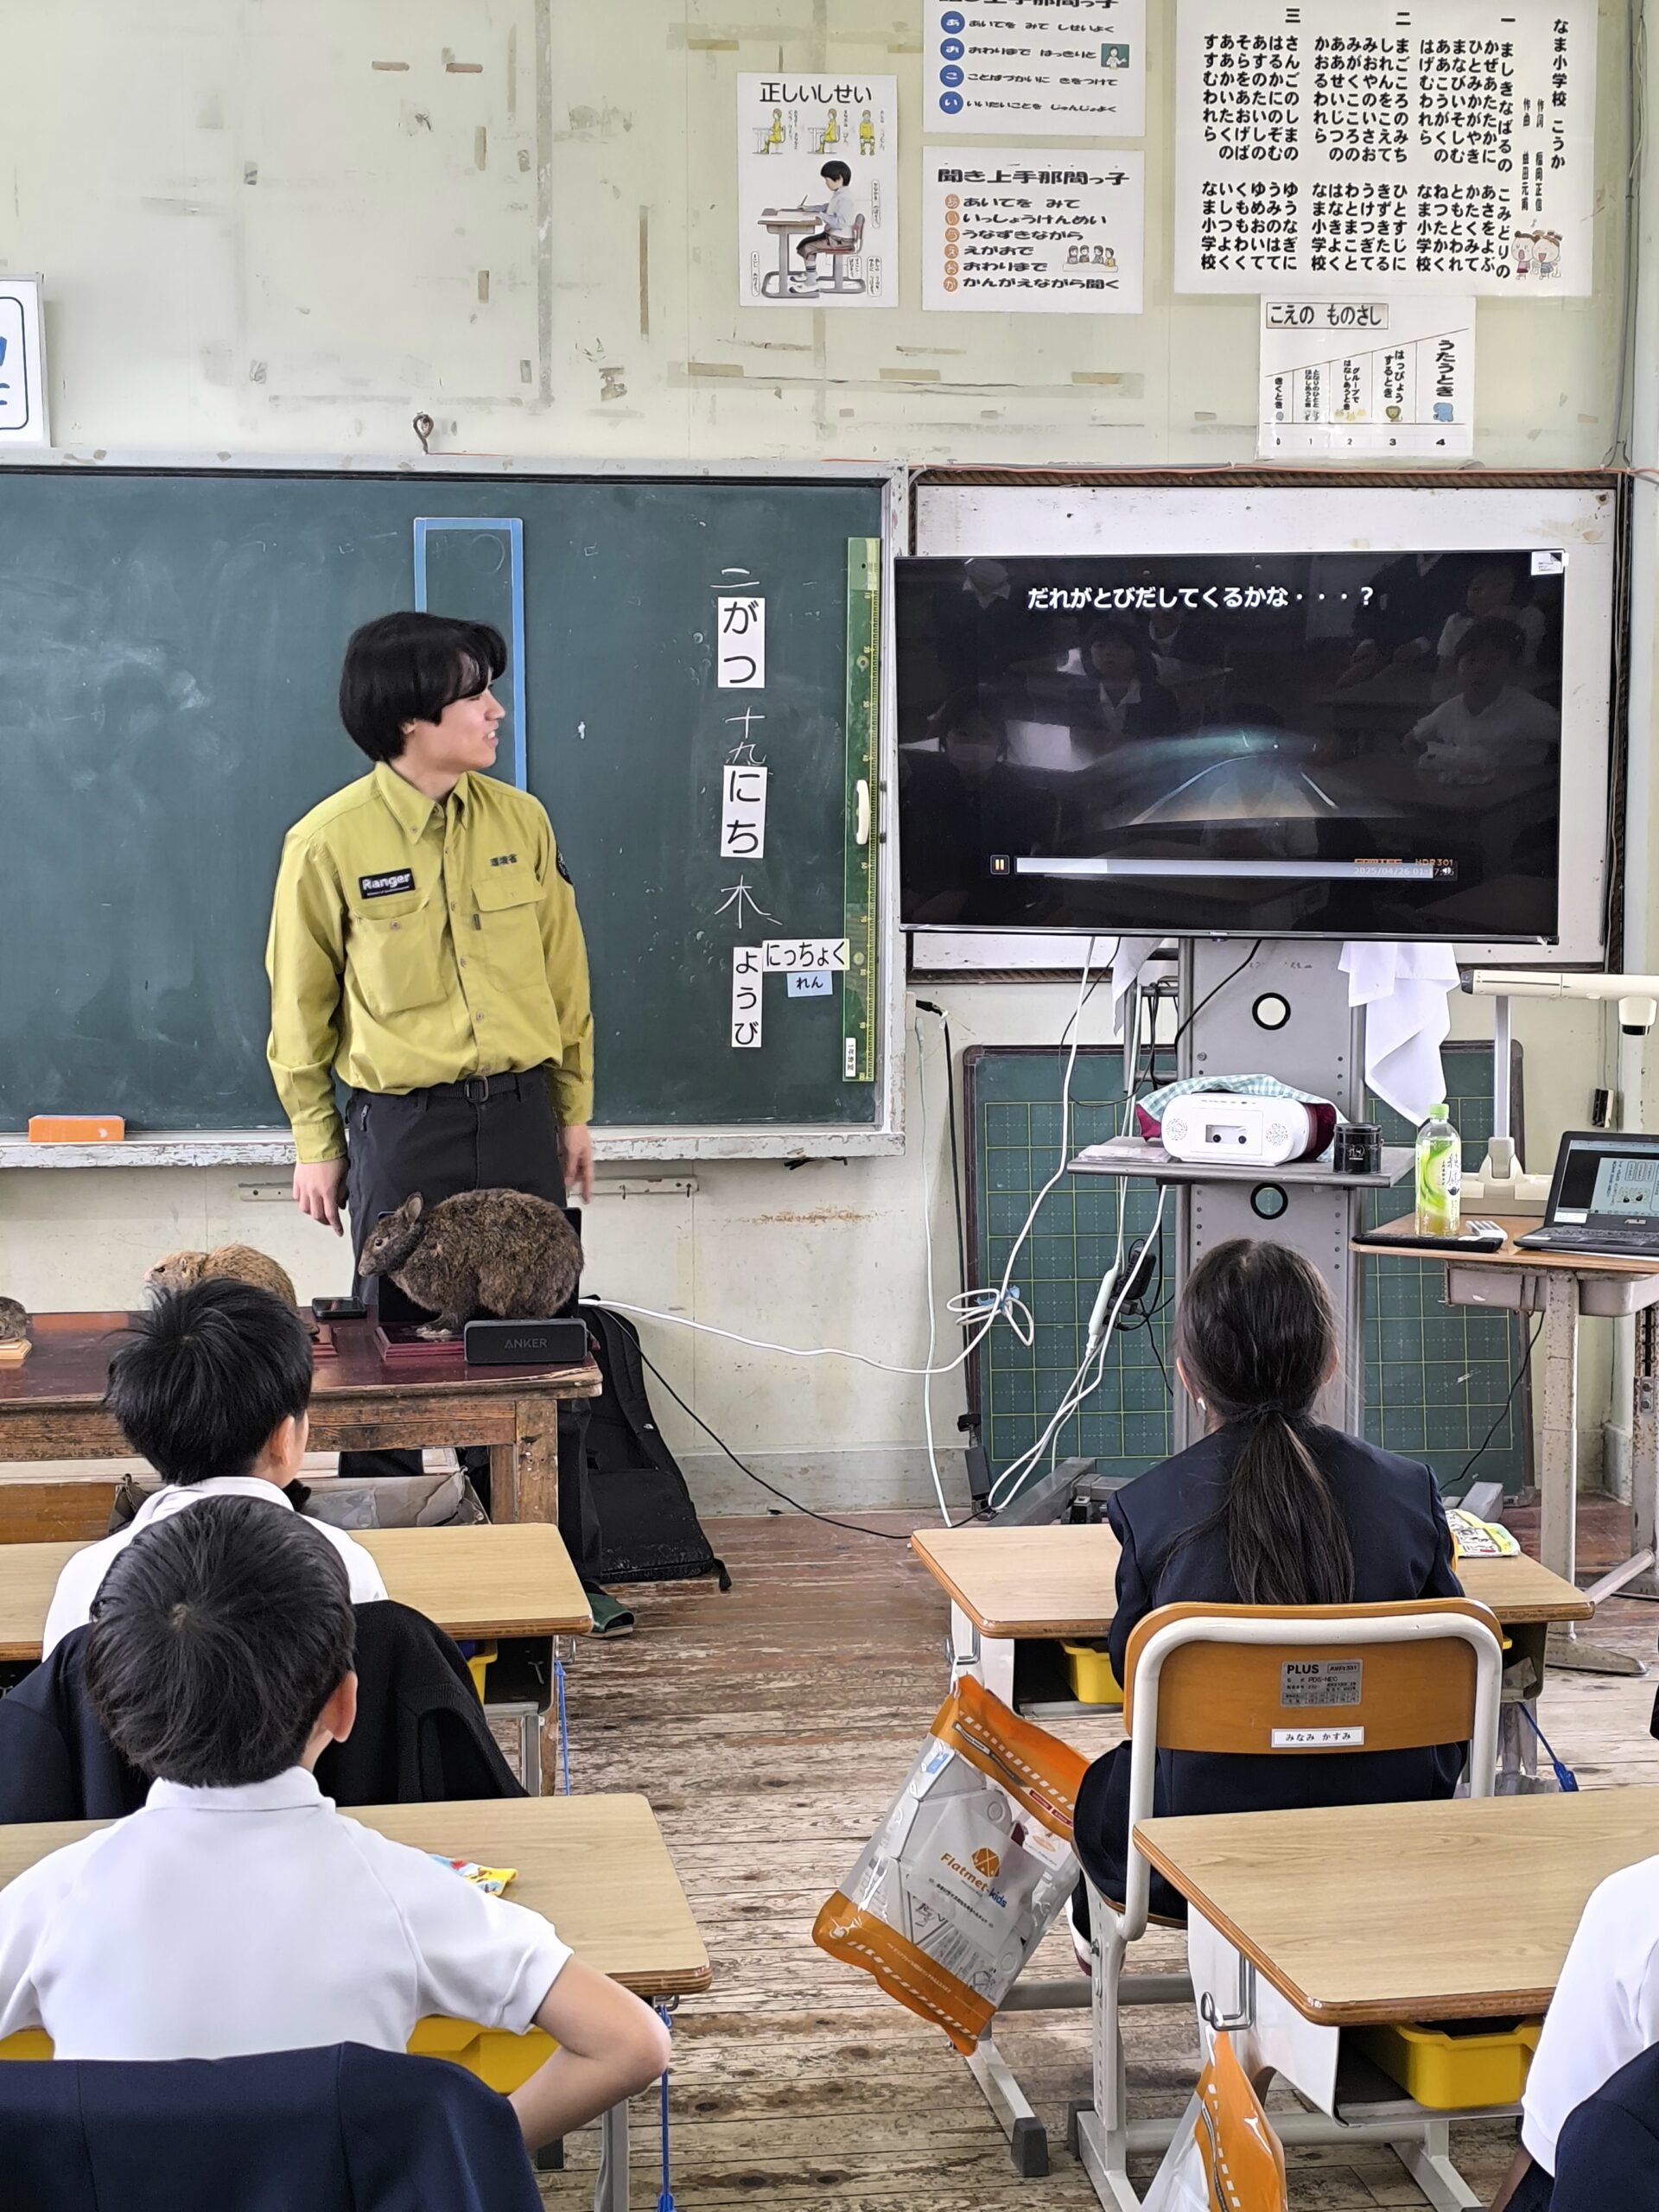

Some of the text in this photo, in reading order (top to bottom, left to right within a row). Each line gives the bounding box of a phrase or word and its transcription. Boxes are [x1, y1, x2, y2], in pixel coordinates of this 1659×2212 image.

[969, 20, 1016, 29] あいてを
[1025, 22, 1050, 30] みて
[1058, 23, 1115, 33] しせいよく
[1285, 8, 1300, 22] 三
[1395, 12, 1411, 25] 二
[968, 47, 1031, 56] おわりまで
[1040, 49, 1097, 59] はっきりと
[968, 73, 1051, 84] ことばづかいに
[1059, 77, 1118, 86] きをつけて
[760, 81, 872, 104] 正しいしせい
[967, 100, 1042, 111] いいたいことを
[1550, 19, 1568, 169] なま小学校 こうか
[938, 168, 1129, 186] 聞き上手那間っ子
[1201, 34, 1219, 270] すすむわれら なま小学校
[1217, 34, 1236, 270] ああかいたくの いしつよく
[1234, 35, 1251, 270] そらをあおげば くももわく
[1250, 35, 1268, 270] あすのたいしの ゆめおいて
[1266, 35, 1283, 270] はるかにのぞむ うみのはて
[1282, 35, 1300, 270] さんごのしまの ゆうなぎに
[1312, 36, 1330, 271] かおるわれら なま小学校
[1328, 36, 1345, 270] ああせいじつの はなきよく
[1344, 37, 1363, 270] みがくこころの わとまこと
[1360, 37, 1378, 270] みおやのいさお うけつぎて
[1376, 37, 1394, 271] しれんをこえて きずきたる
[1393, 38, 1410, 271] まごころのみち ひとすじに
[1416, 39, 1435, 272] はげむわれら なま小学校
[1433, 39, 1452, 272] ああこうがくの ねつたかく
[1449, 39, 1467, 271] まなびいそしむ ともとわれ
[1465, 40, 1483, 272] ひとみかがやき かたくみて
[1481, 40, 1499, 272] かぜあたたかに あさをよぶ
[1496, 42, 1514, 279] ましきなばるの こみどりの
[963, 198, 1033, 208] あいてを
[1046, 198, 1081, 208] みて
[963, 213, 1107, 226] いっしょうけんめい
[962, 230, 1084, 241] うなずきながら
[963, 245, 1034, 256] えがおで
[963, 262, 1048, 272] おわりまで
[963, 278, 1120, 289] かんがえながら聞く
[1270, 304, 1382, 326] こえの ものさし
[1383, 355, 1394, 398] するとき
[1395, 350, 1405, 404] はっぴょう
[1435, 340, 1456, 397] うたうとき
[709, 567, 760, 588] 二
[723, 601, 759, 683] がつ
[727, 770, 761, 854] にち
[362, 873, 410, 890] Ranger
[714, 874, 772, 929] 木
[766, 941, 846, 967] にっちょく
[734, 951, 760, 1045] ようび
[796, 976, 824, 989] れん
[504, 1338, 548, 1349] ANKER
[1287, 1664, 1319, 1675] PLUS
[1286, 1732, 1351, 1742] みなみ かすみ
[940, 1852, 1007, 1908] Flatmet-kids
